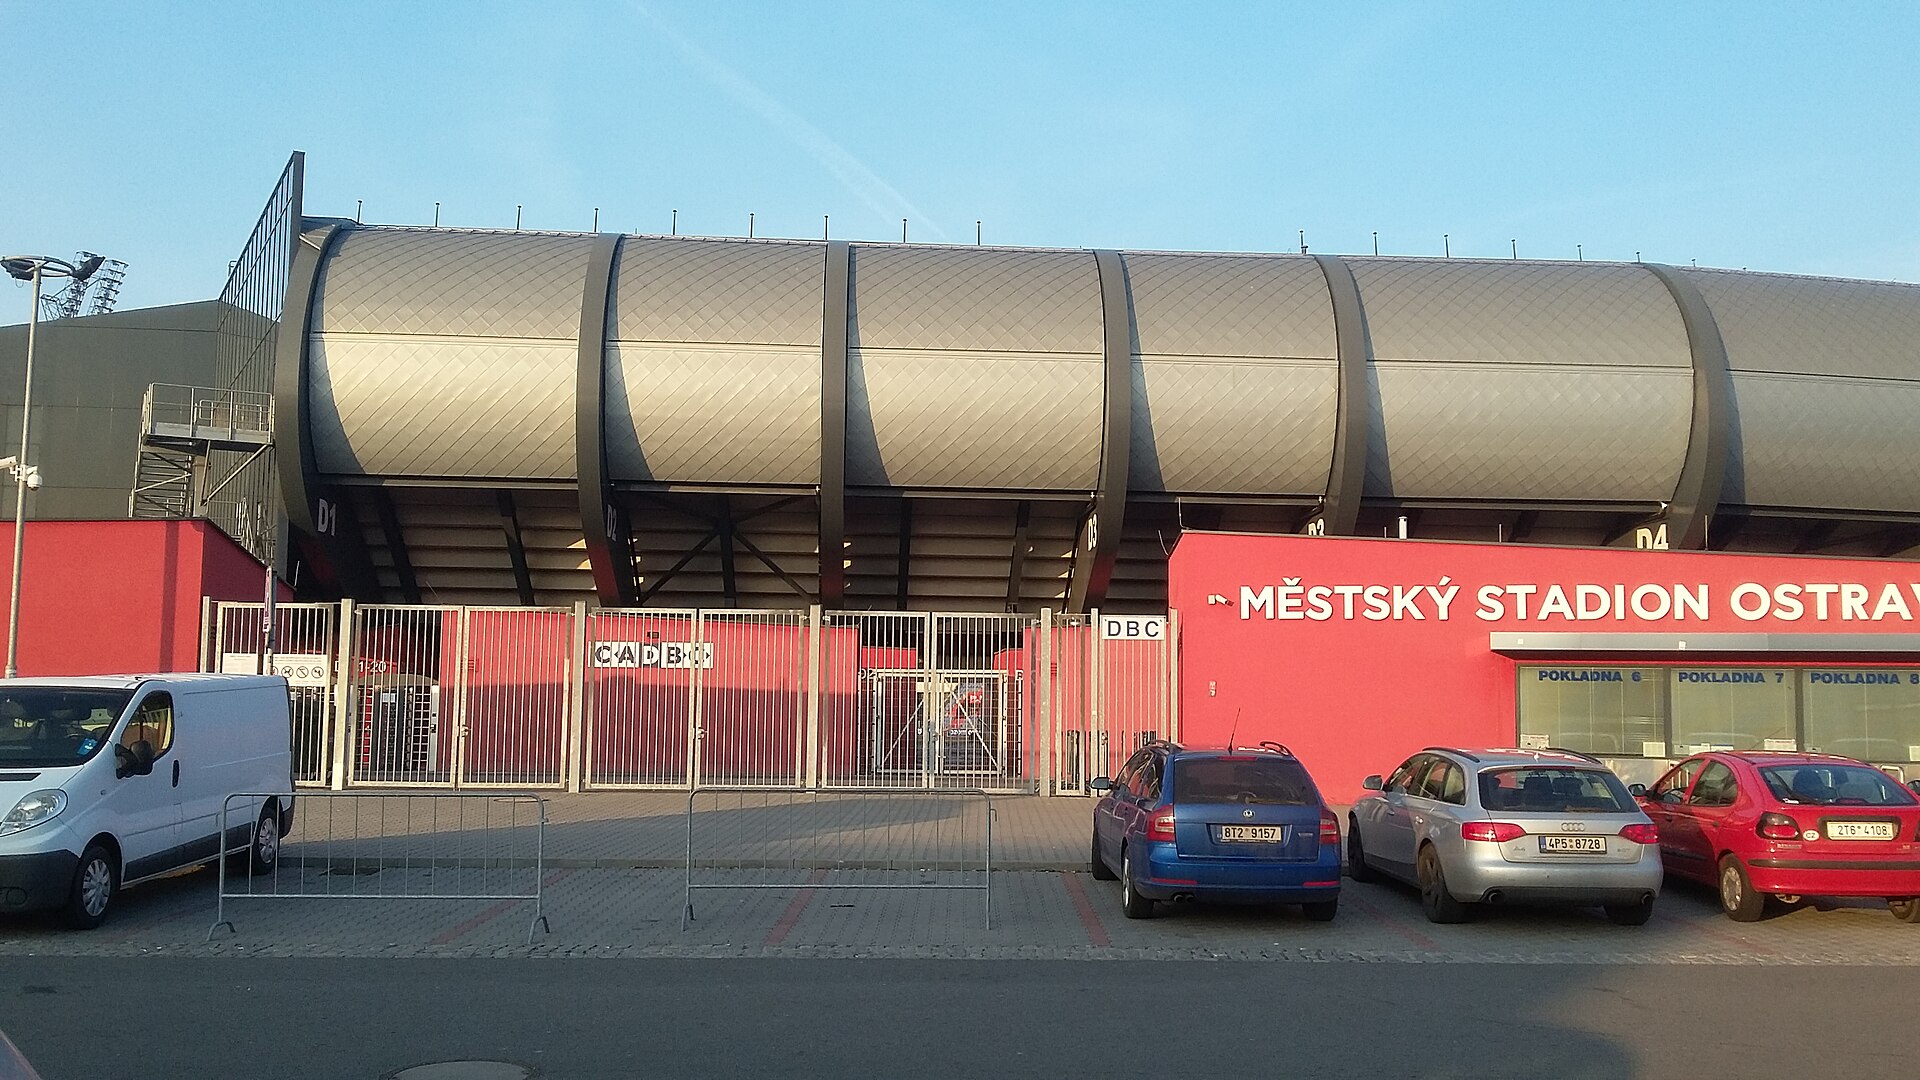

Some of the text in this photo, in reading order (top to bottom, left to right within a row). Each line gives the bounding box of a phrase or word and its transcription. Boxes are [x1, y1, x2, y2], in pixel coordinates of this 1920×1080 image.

[317, 498, 337, 536] D1
[606, 504, 617, 542] D2
[1087, 513, 1098, 552] D3
[1636, 523, 1669, 550] D4
[1239, 575, 1920, 622] MĚSTSKÝ STADION OSTRA
[1538, 670, 1642, 682] POKLADNA 6
[1678, 671, 1785, 684] POKLADNA 7
[1810, 672, 1920, 685] POKLADNA 8
[1224, 827, 1277, 839] 8T2 9157
[1548, 838, 1601, 850] 4P5 8728
